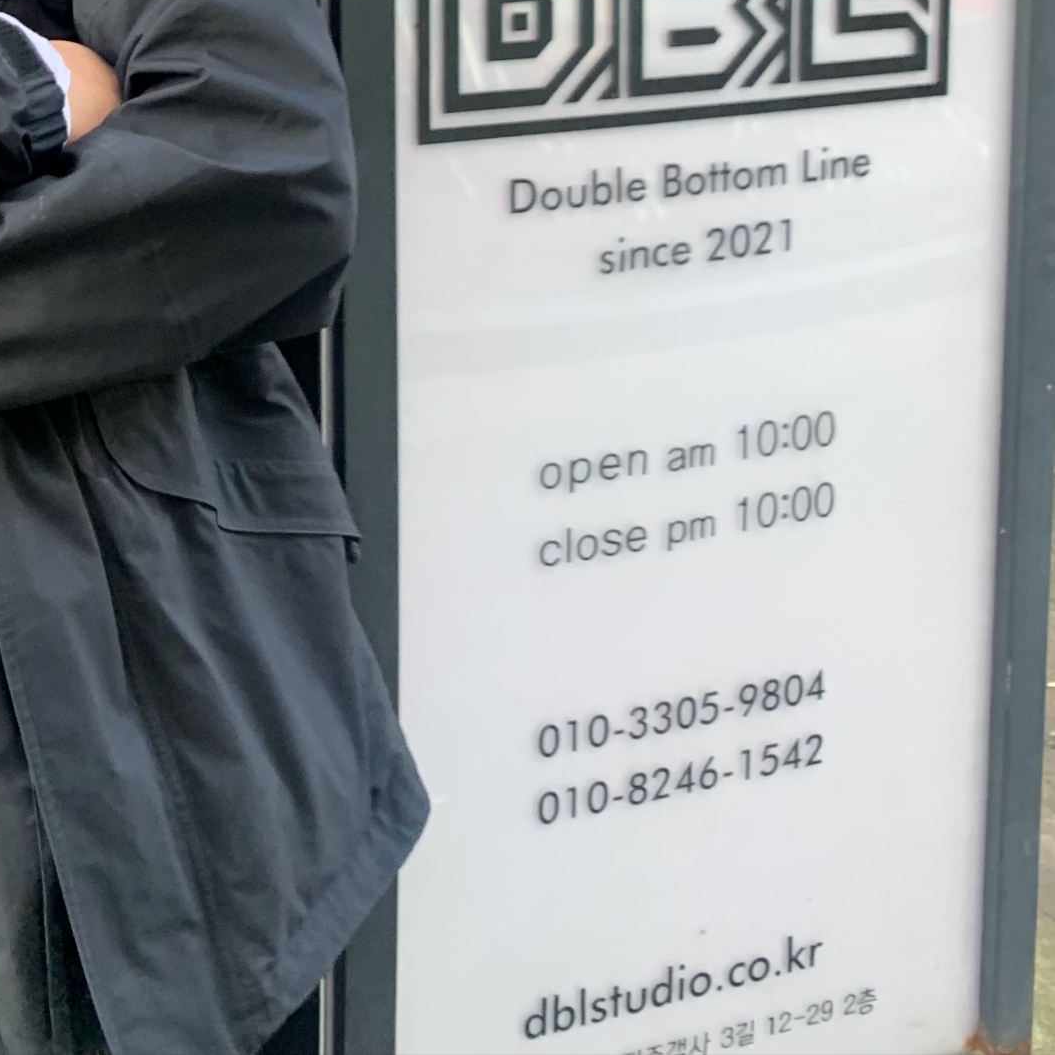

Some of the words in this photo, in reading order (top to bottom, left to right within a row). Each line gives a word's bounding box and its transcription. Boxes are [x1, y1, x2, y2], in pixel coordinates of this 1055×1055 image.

[508, 168, 647, 215] Double
[662, 160, 787, 199] Bottom
[801, 147, 871, 184] Line
[598, 237, 692, 275] since
[706, 218, 793, 263] 2021
[539, 449, 648, 493] open
[666, 443, 716, 472] am
[736, 410, 836, 459] 10:00
[538, 525, 648, 566] close
[666, 515, 716, 551] pm
[736, 481, 835, 532] 10:00
[537, 669, 826, 758] 010-3305-9804
[537, 733, 824, 825] 010-8246-1542
[523, 935, 824, 1040] dblstudio.co.kr
[720, 1019, 755, 1049] 3길
[768, 1000, 834, 1036] 12-29
[843, 988, 878, 1016] 2층
